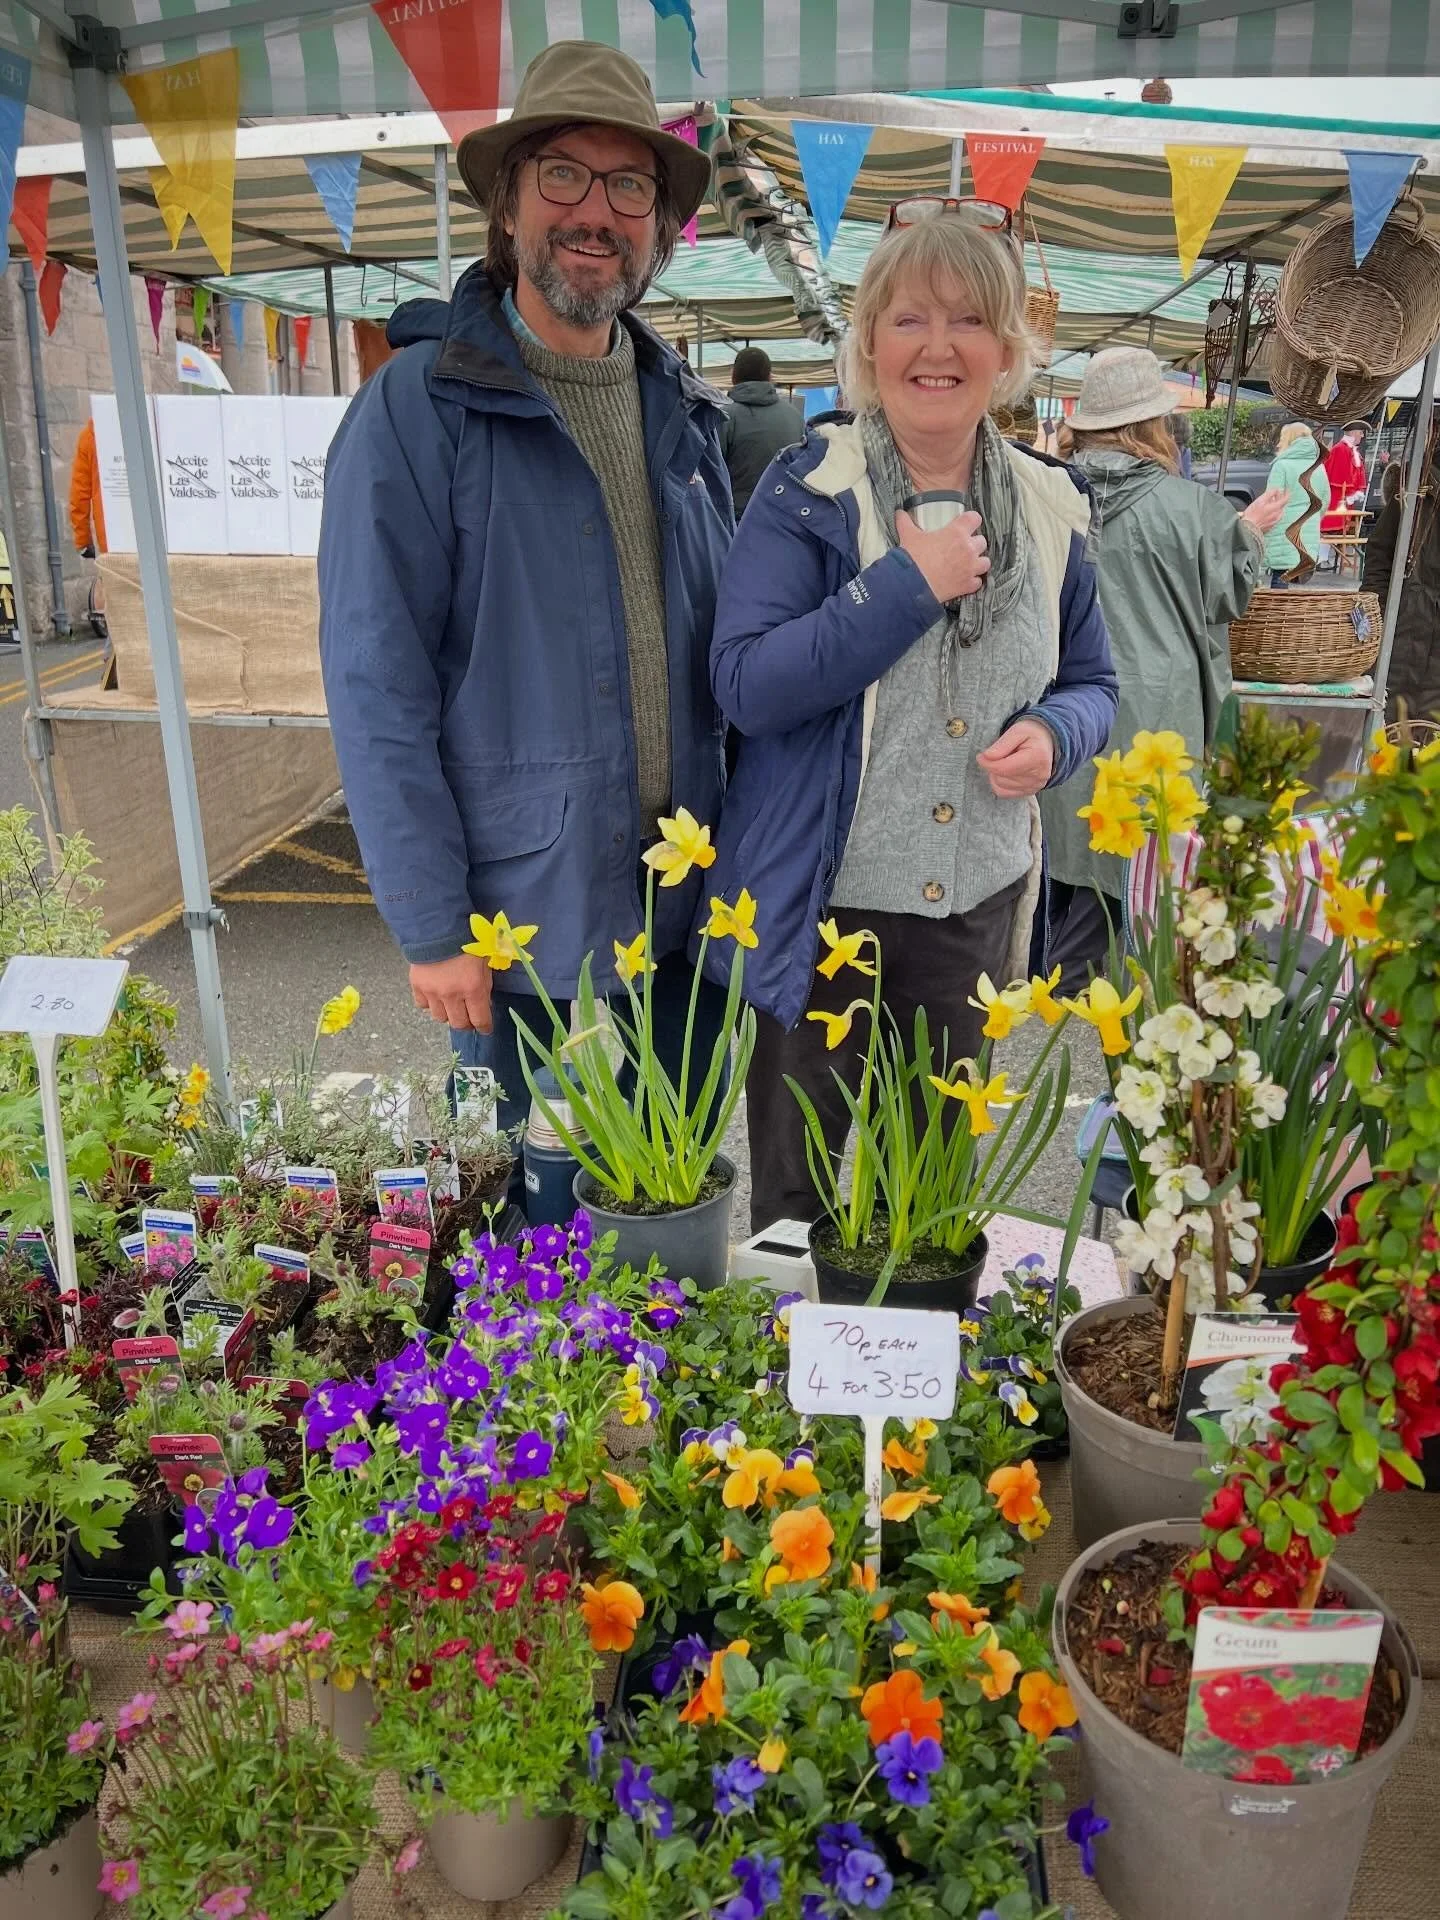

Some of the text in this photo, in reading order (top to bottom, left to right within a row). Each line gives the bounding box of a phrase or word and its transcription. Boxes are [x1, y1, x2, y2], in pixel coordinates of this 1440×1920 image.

[818, 131, 847, 145] HAY
[974, 142, 1036, 153] FESTIVAL
[1188, 155, 1216, 168] HAY
[175, 455, 208, 466] Aceite
[238, 455, 271, 466] Aceite
[194, 468, 208, 479] de
[256, 468, 271, 479] de
[169, 475, 190, 486] Las
[231, 475, 252, 486] Las
[294, 476, 315, 487] Las
[1208, 1330, 1292, 1345] Chaenome
[879, 1338, 918, 1351] EACH
[808, 1363, 829, 1398] 4
[1214, 1632, 1278, 1649] Geum
